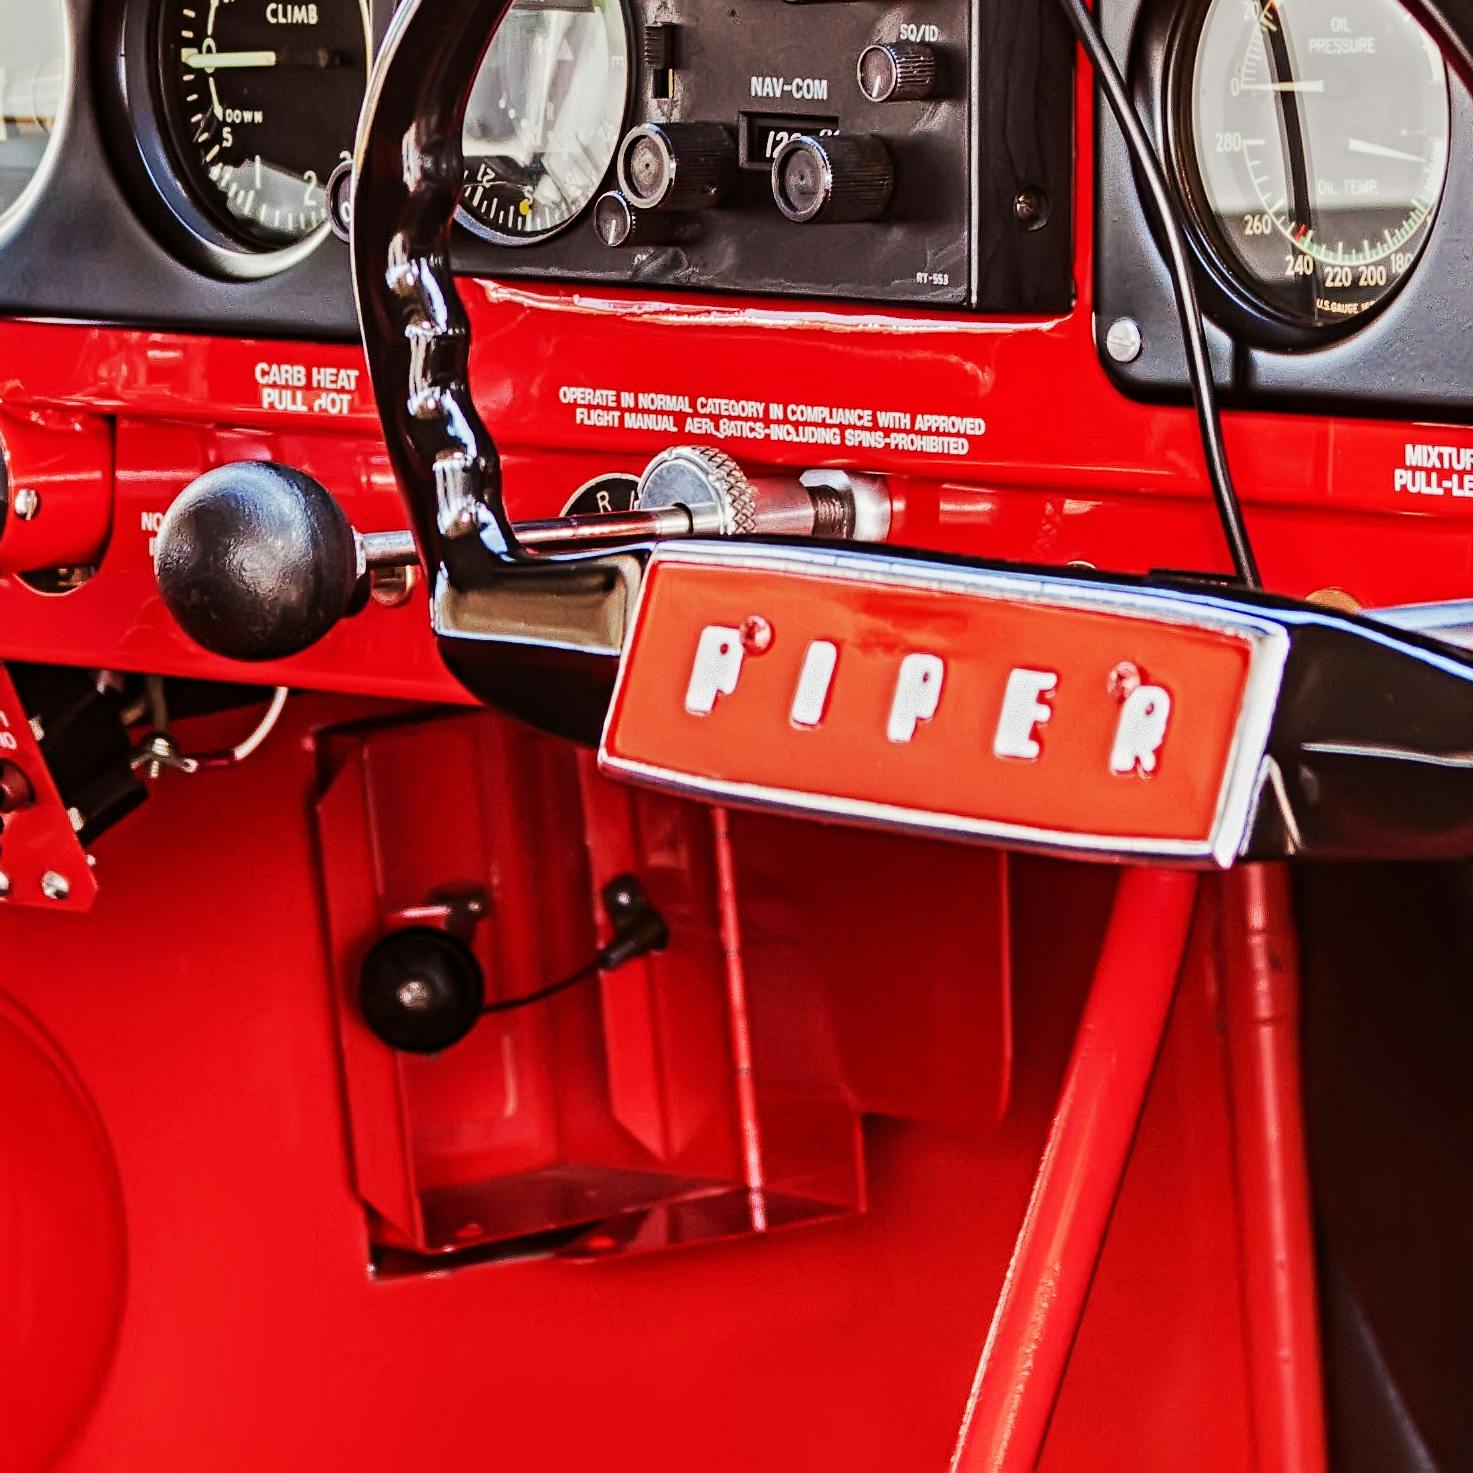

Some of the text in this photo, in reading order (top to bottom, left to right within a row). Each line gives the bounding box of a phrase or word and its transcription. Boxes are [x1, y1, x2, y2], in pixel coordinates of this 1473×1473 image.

[265, 3, 319, 26] CLIMB
[1330, 16, 1353, 34] OIL
[899, 24, 940, 43] SQ/ID
[1308, 37, 1377, 55] PRESSURE
[750, 75, 828, 101] NAV-COM
[225, 110, 264, 124] DOWN
[222, 126, 233, 148] 5
[1215, 131, 1243, 154] 280
[303, 169, 318, 208] 2
[1317, 179, 1336, 196] OIL
[1243, 214, 1272, 236] 260
[1284, 254, 1314, 276] 240
[1358, 265, 1387, 287] 200
[1324, 266, 1353, 288] 220
[255, 362, 359, 391] CARB HEAT
[261, 387, 308, 412] PULL
[559, 385, 986, 436] OPERATE IN NORMAL CATEGORY IN COMPLIANCE WITH APPROVED
[575, 407, 621, 428] FLIGHT
[624, 411, 678, 433] MANUAL
[684, 624, 1172, 778] PIPER
